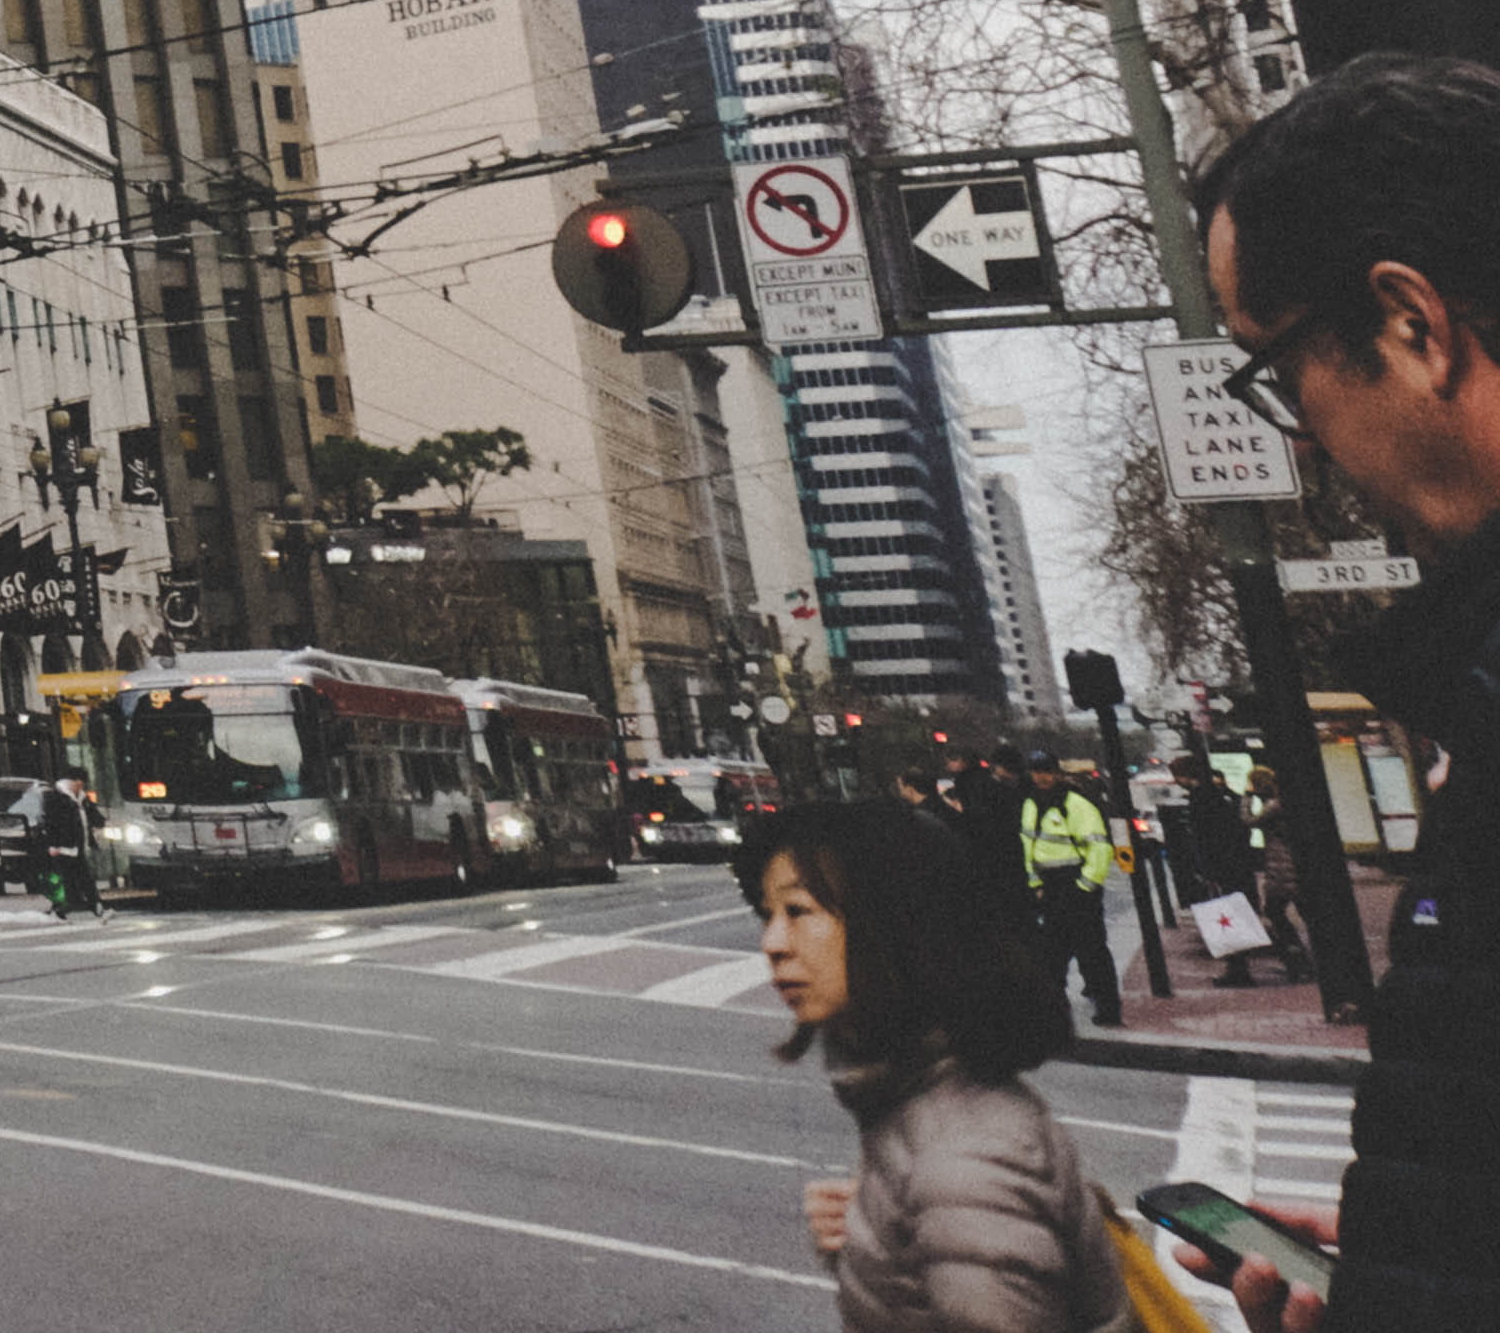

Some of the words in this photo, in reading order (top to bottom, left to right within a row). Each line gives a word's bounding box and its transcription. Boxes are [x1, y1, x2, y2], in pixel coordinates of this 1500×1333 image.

[405, 7, 496, 40] BUILDING
[930, 230, 972, 248] ONE
[985, 226, 1025, 242] WAY
[758, 262, 815, 281] EXCEPT
[822, 260, 864, 278] MUNI
[765, 288, 822, 305] EXCEPT
[831, 285, 865, 301] TAXI
[799, 305, 836, 317] FROM
[1179, 357, 1236, 376] BUS
[1184, 385, 1223, 401] AN
[1187, 410, 1254, 428] TAXI
[1184, 436, 1266, 456] LANE
[1191, 463, 1271, 483] ENDS
[1316, 565, 1366, 583] 3RD
[1385, 563, 1412, 581] ST
[31, 578, 61, 605] 60
